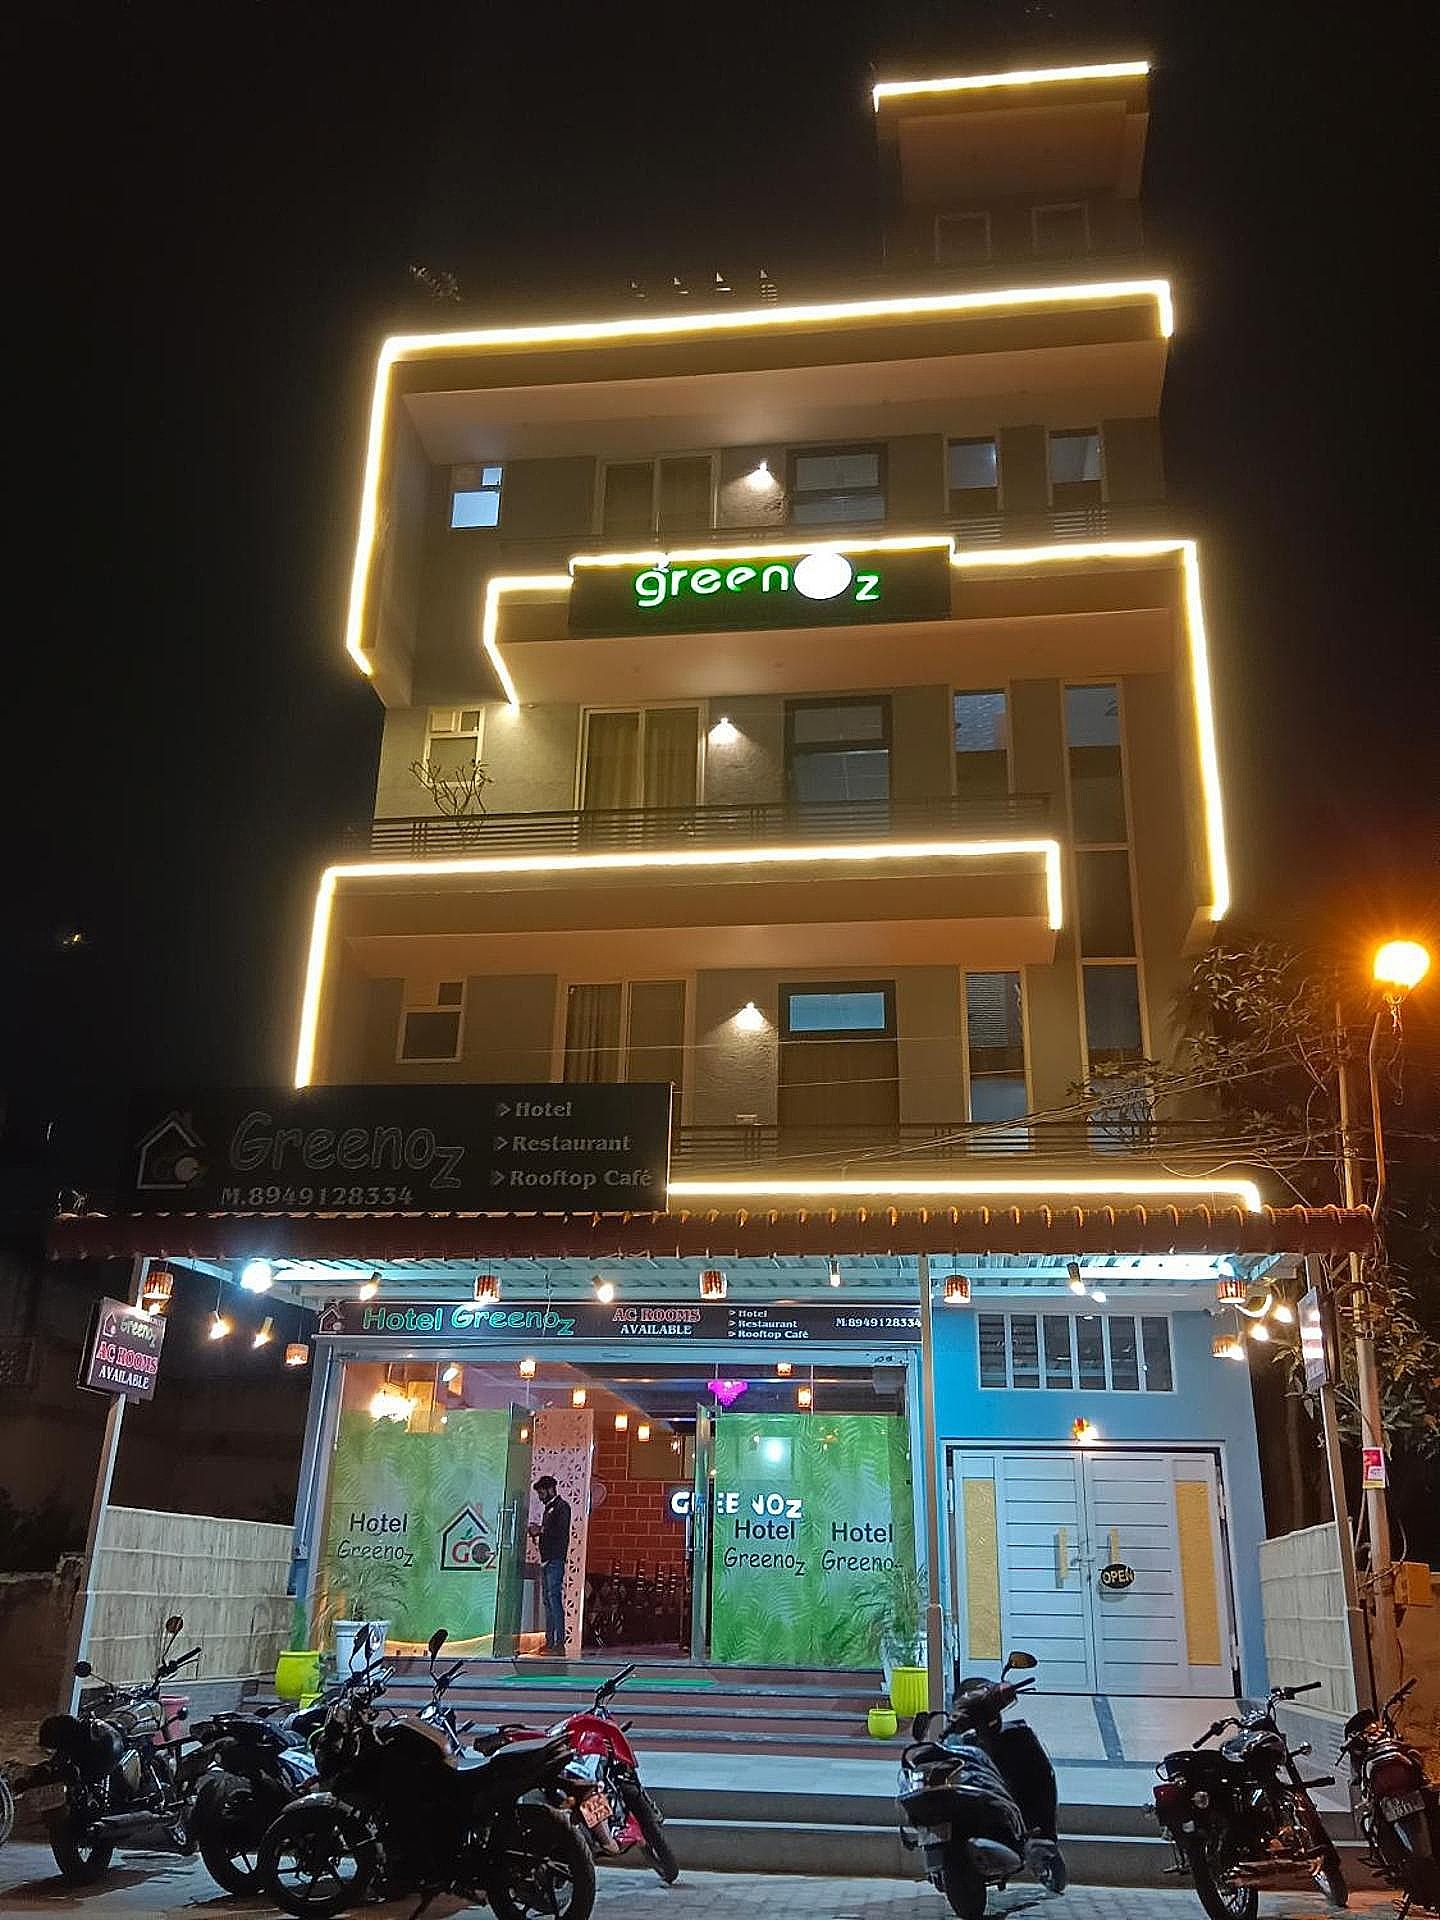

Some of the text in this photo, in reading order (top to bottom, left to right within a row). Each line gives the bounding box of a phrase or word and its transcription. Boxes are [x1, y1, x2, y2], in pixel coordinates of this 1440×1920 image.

[515, 1101, 572, 1117] Hotel
[229, 1111, 465, 1189] Greenoz
[512, 1135, 632, 1151] Restaurant
[509, 1168, 650, 1190] Rooftop Café
[362, 1305, 576, 1336] Hotel Greenoz
[612, 1307, 701, 1323] AC ROOMS
[738, 1309, 768, 1318] Hotel
[738, 1320, 798, 1328] Restaurant
[620, 1324, 692, 1335] AVAILABLE
[738, 1330, 782, 1340] Rooftop
[96, 1341, 159, 1374] AC ROOMS
[98, 1364, 150, 1390] AVAILABLE
[350, 1512, 408, 1533] Hotel
[734, 1519, 795, 1540] Hotel
[831, 1522, 893, 1543] Hotel
[337, 1539, 415, 1568] Greenoz
[724, 1547, 807, 1576] Greenoz
[822, 1549, 904, 1571] Greeno
[1103, 1567, 1133, 1584] OPEN
